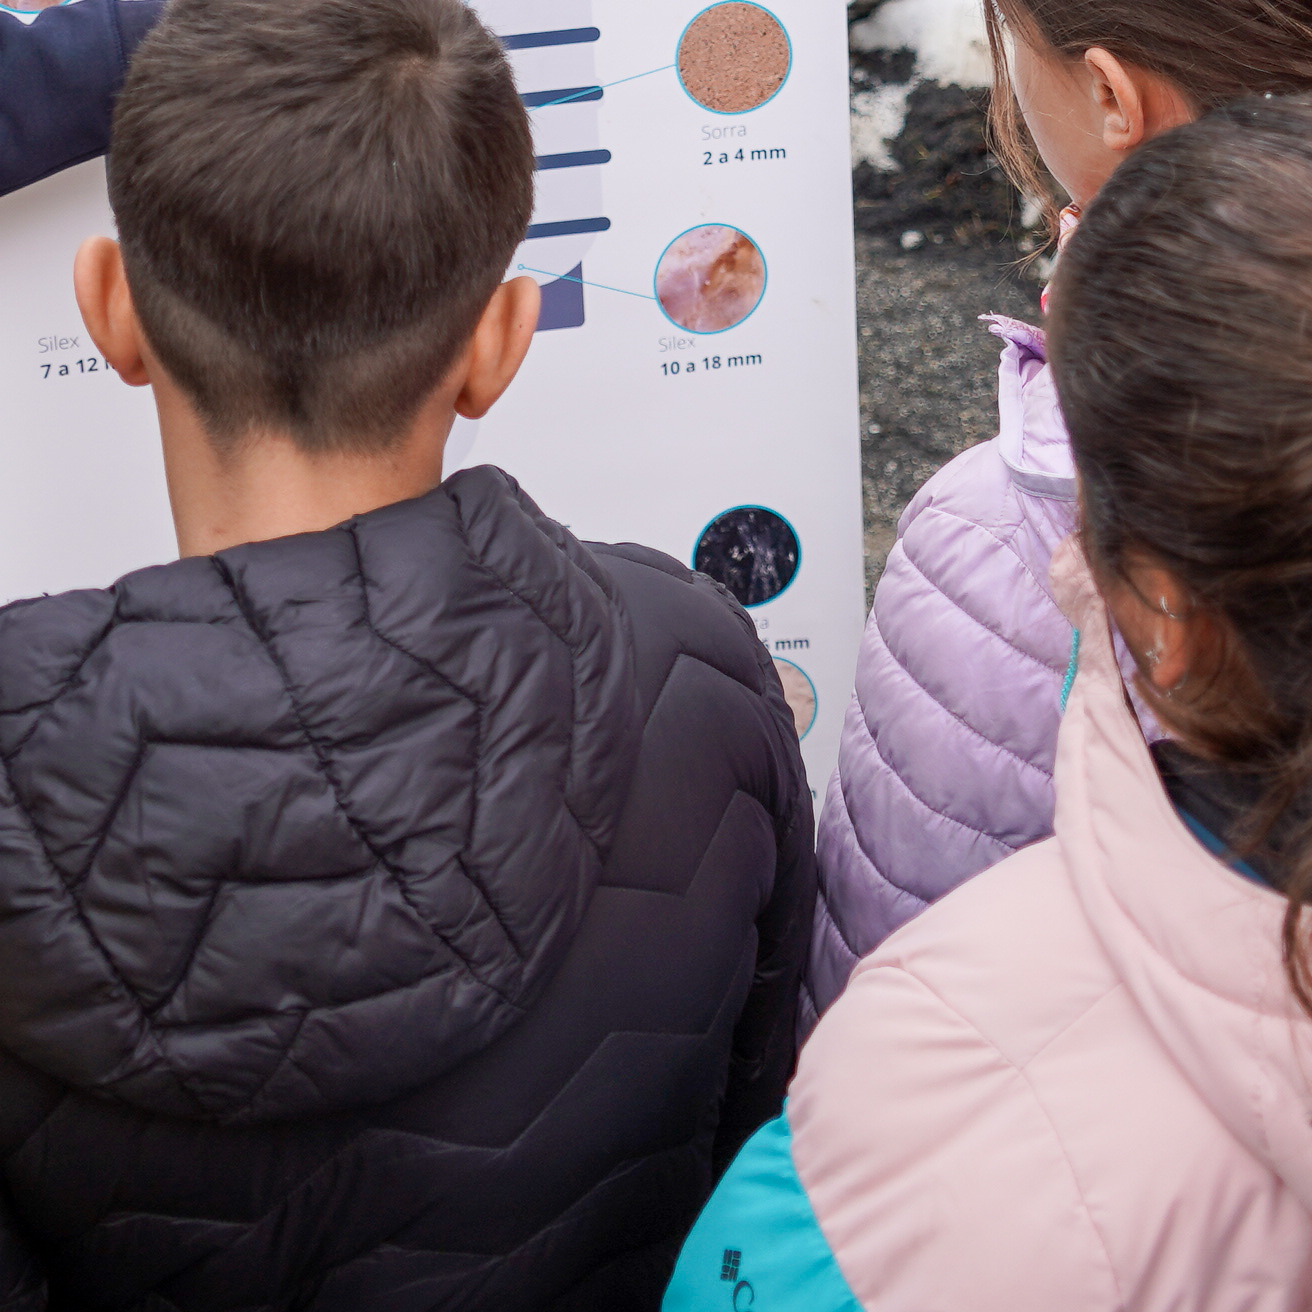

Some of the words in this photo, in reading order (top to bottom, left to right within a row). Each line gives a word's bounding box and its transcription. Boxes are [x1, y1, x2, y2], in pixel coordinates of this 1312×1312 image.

[701, 124, 747, 141] Sorra
[703, 151, 713, 165] 2
[719, 153, 729, 164] a
[734, 148, 745, 161] 4
[751, 147, 787, 161] mm
[38, 335, 80, 354] Silex
[658, 336, 696, 353] Silex
[40, 363, 52, 379] 7
[58, 364, 69, 376] a
[75, 357, 99, 373] 12
[661, 361, 680, 376] 10
[686, 362, 696, 373] a
[702, 355, 722, 371] 18
[727, 353, 763, 367] mm
[775, 639, 810, 650] mm
